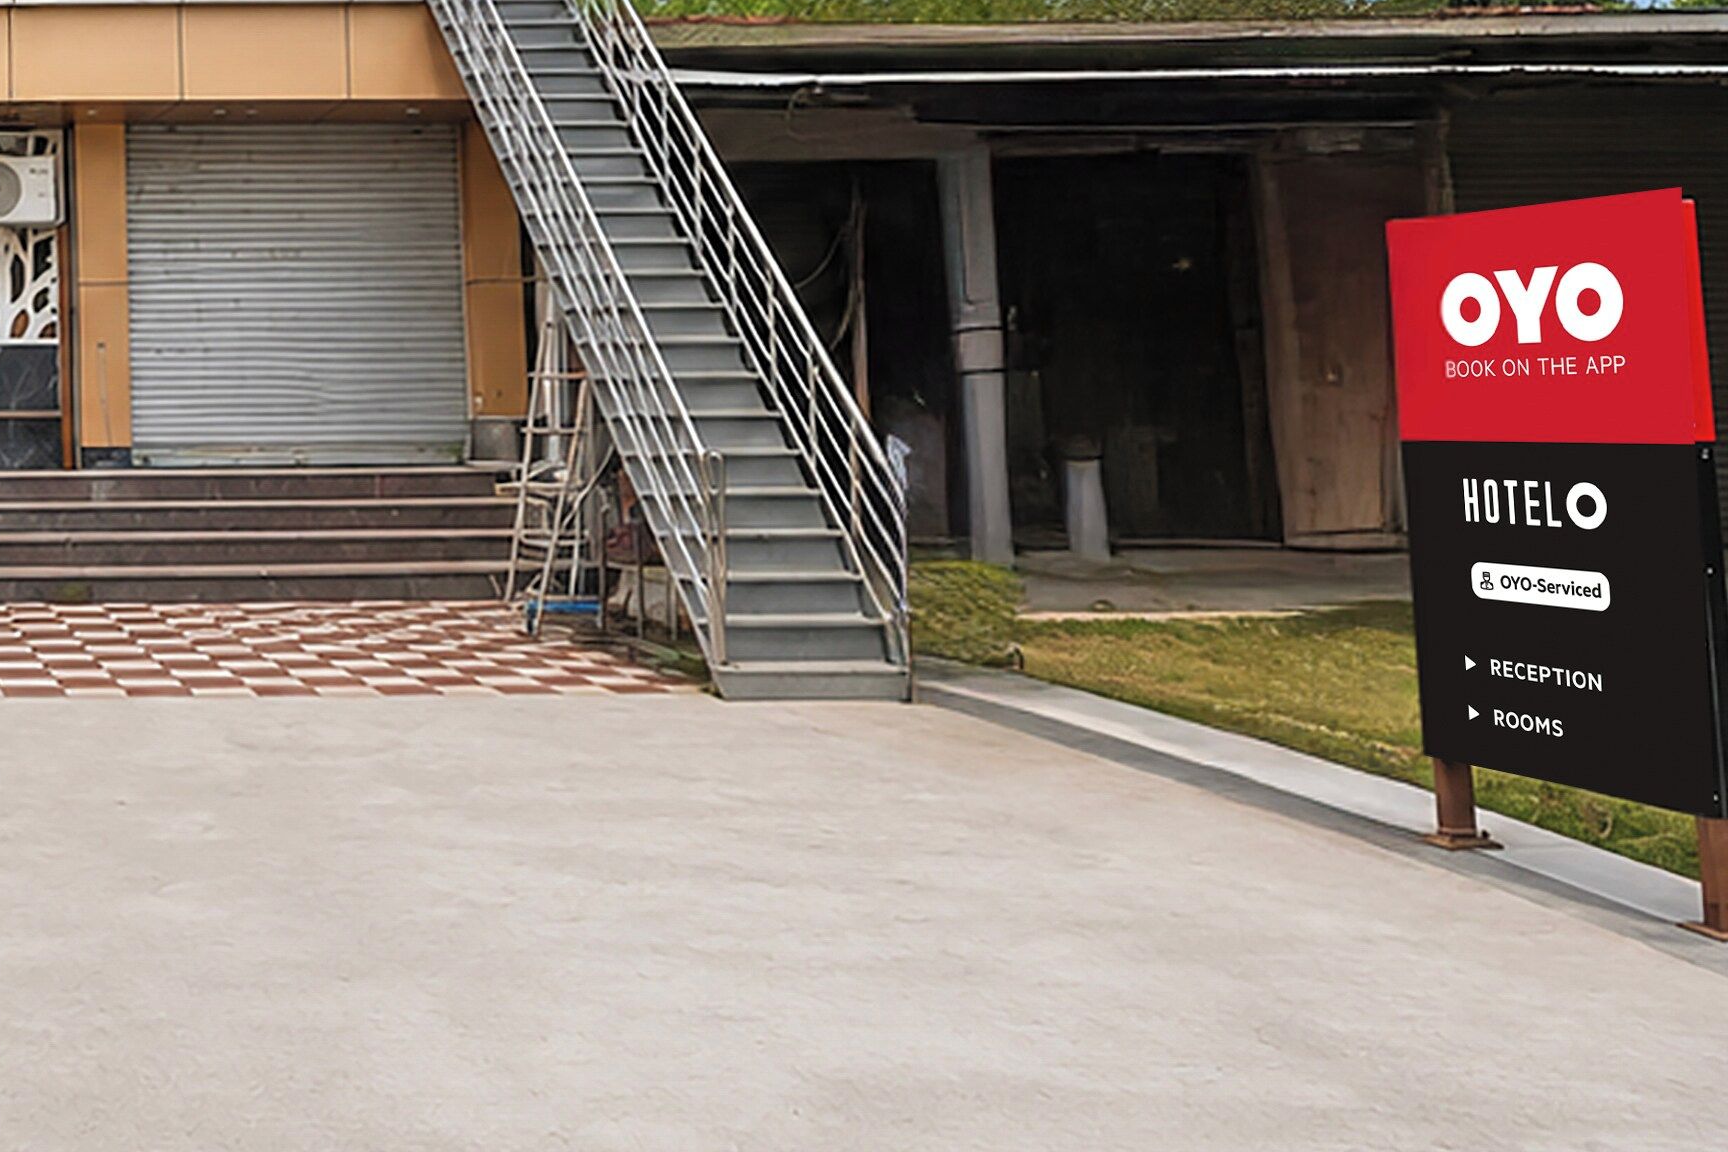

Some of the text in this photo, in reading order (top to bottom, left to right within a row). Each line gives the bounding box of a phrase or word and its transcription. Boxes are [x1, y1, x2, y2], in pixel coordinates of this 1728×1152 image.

[1440, 262, 1624, 347] OYO
[1445, 355, 1627, 378] BOOK ON THE APP
[1499, 573, 1603, 600] OYO-Serviced
[1489, 658, 1604, 692] RECEPTION
[1493, 708, 1564, 738] ROOMS
